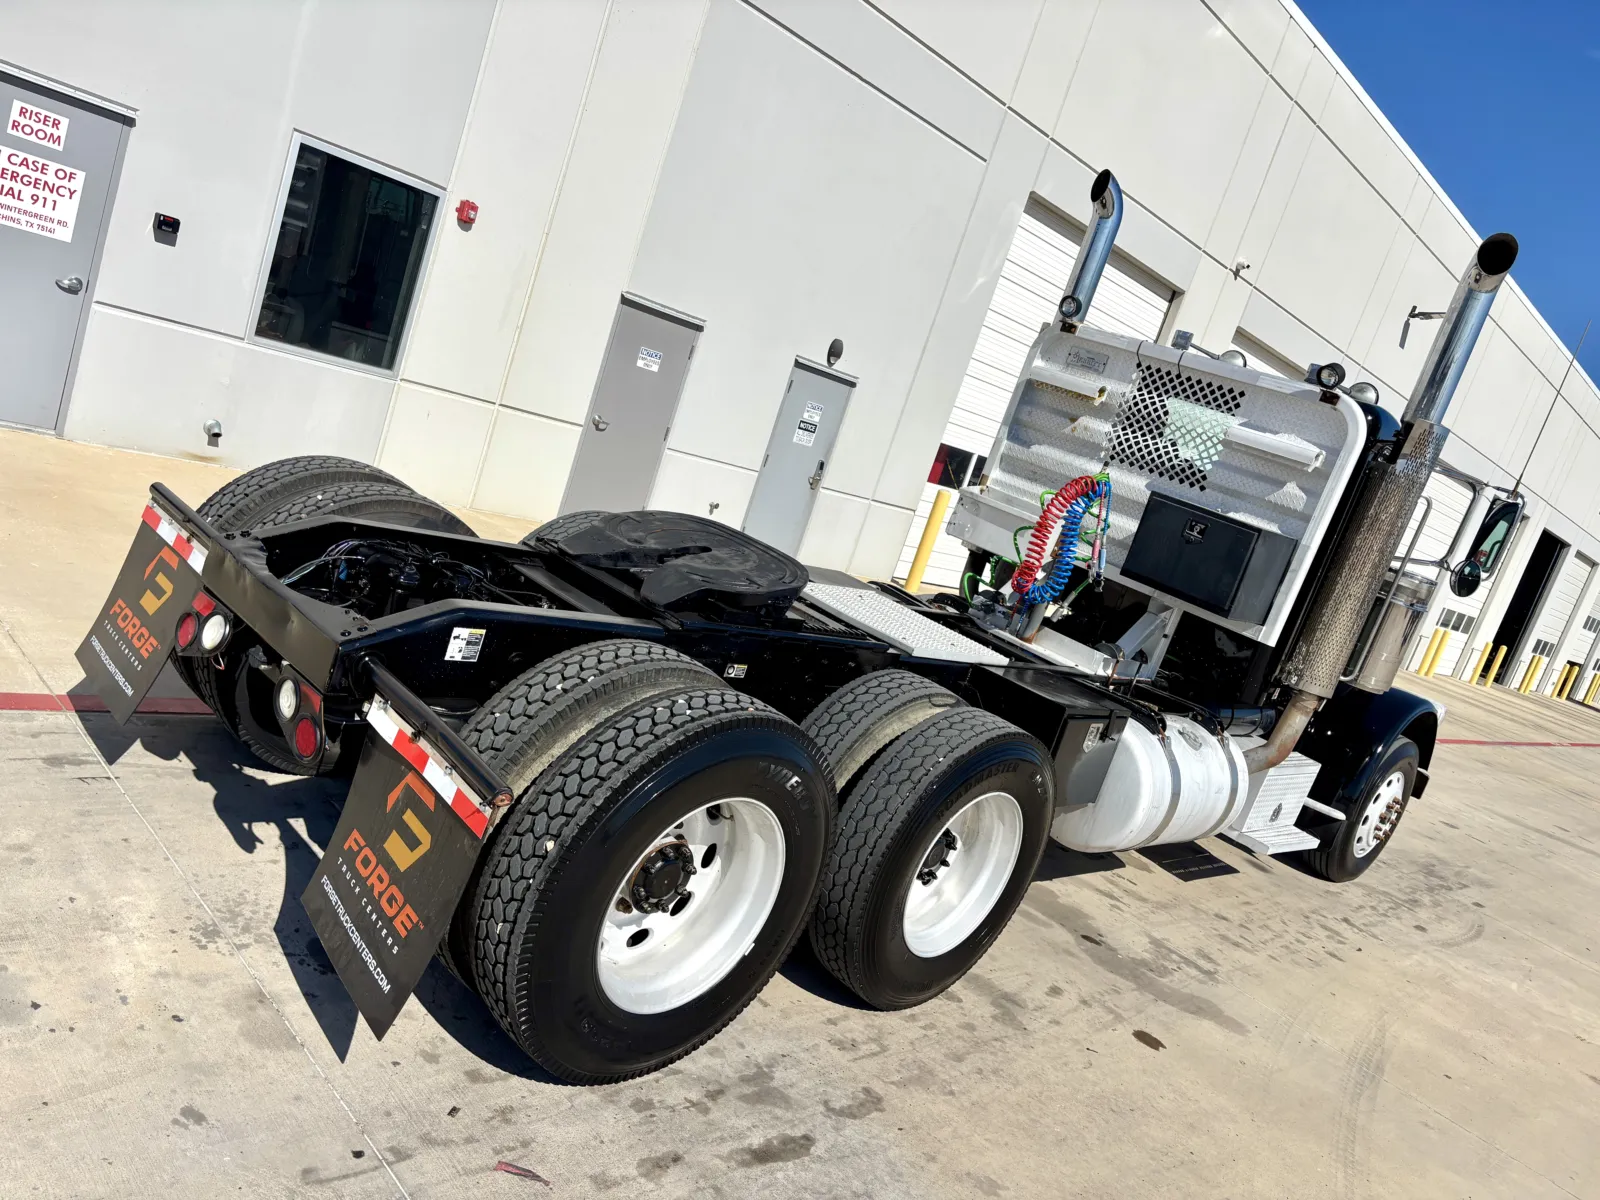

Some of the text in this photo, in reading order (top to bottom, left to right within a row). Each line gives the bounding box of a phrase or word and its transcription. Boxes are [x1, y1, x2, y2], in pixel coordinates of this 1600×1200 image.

[19, 106, 61, 131] RISER
[11, 119, 61, 146] ROOM
[7, 153, 49, 175] CASE
[54, 168, 77, 183] OF
[30, 193, 57, 211] 911
[25, 220, 34, 228] TX
[36, 223, 55, 234] 75141
[56, 219, 69, 228] RD.
[640, 347, 662, 360] NOTICE
[799, 422, 816, 432] NOTICE
[109, 598, 158, 659] FORGE
[89, 634, 135, 697] FORGETRUCKCENTERS.COM
[343, 828, 419, 939] FORGE
[337, 856, 399, 955] TRUCK CENTERS
[320, 874, 392, 994] FORGETRUCKCENTERS.COM
